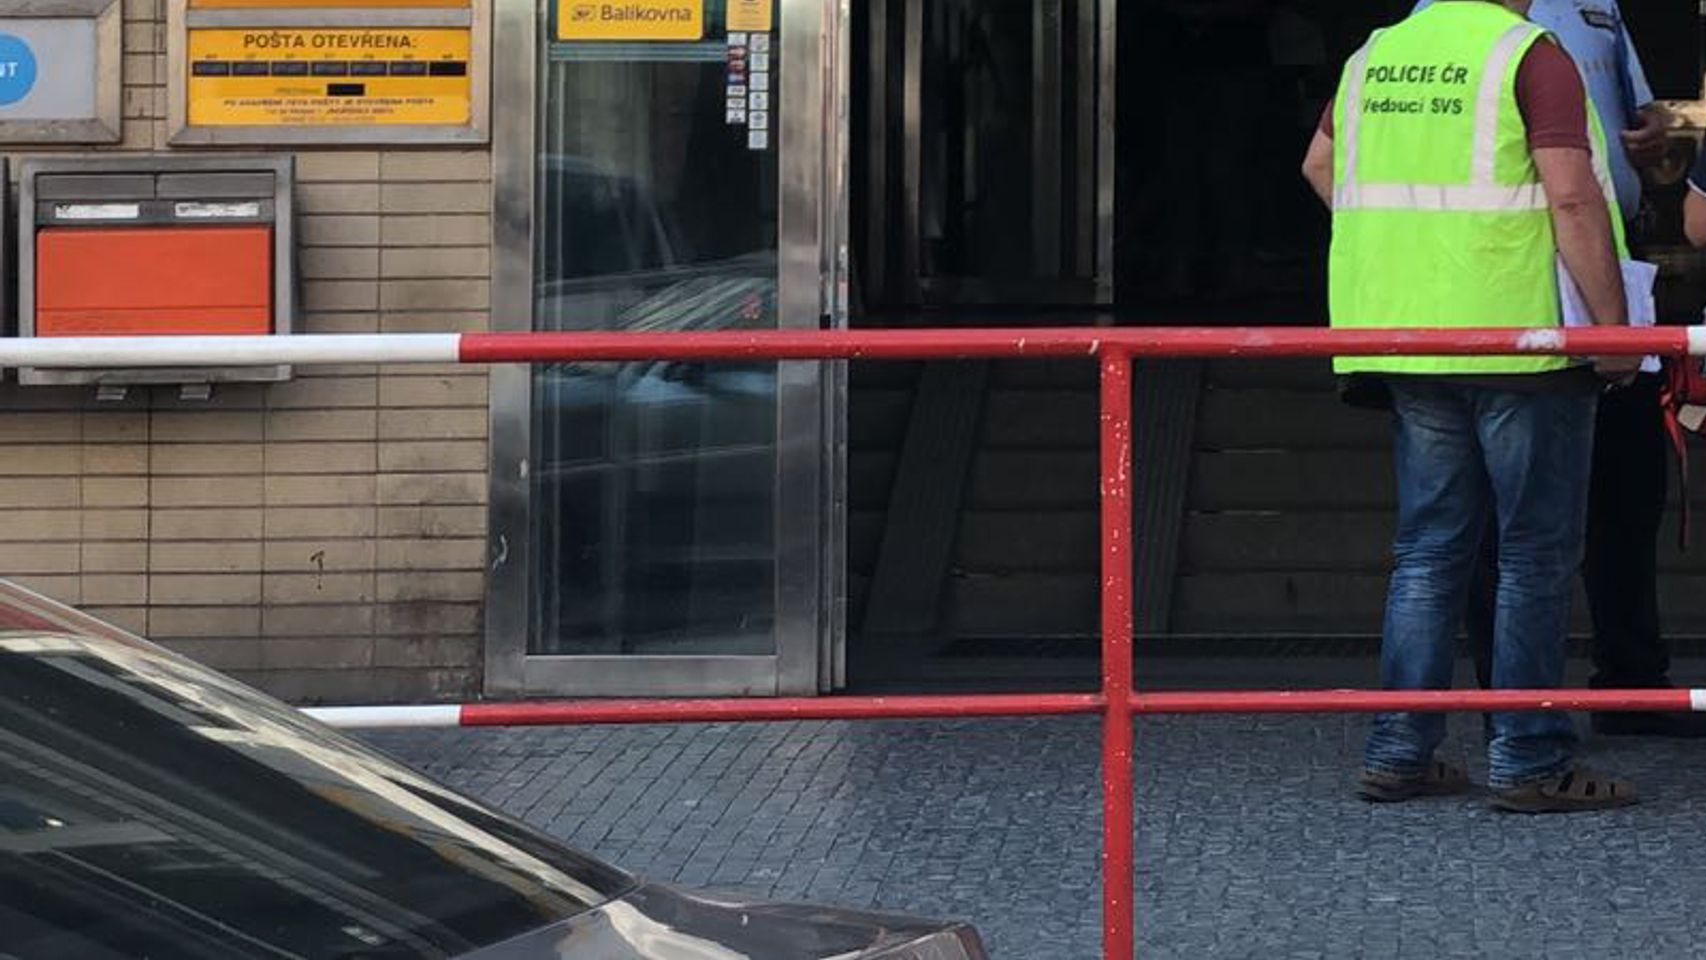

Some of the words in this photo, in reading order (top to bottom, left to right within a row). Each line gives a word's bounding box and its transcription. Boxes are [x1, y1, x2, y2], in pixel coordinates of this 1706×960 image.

[243, 33, 304, 49] POŠTA
[1365, 66, 1436, 84] POLICIE
[1440, 63, 1468, 84] ČR
[1431, 98, 1463, 115] SVS
